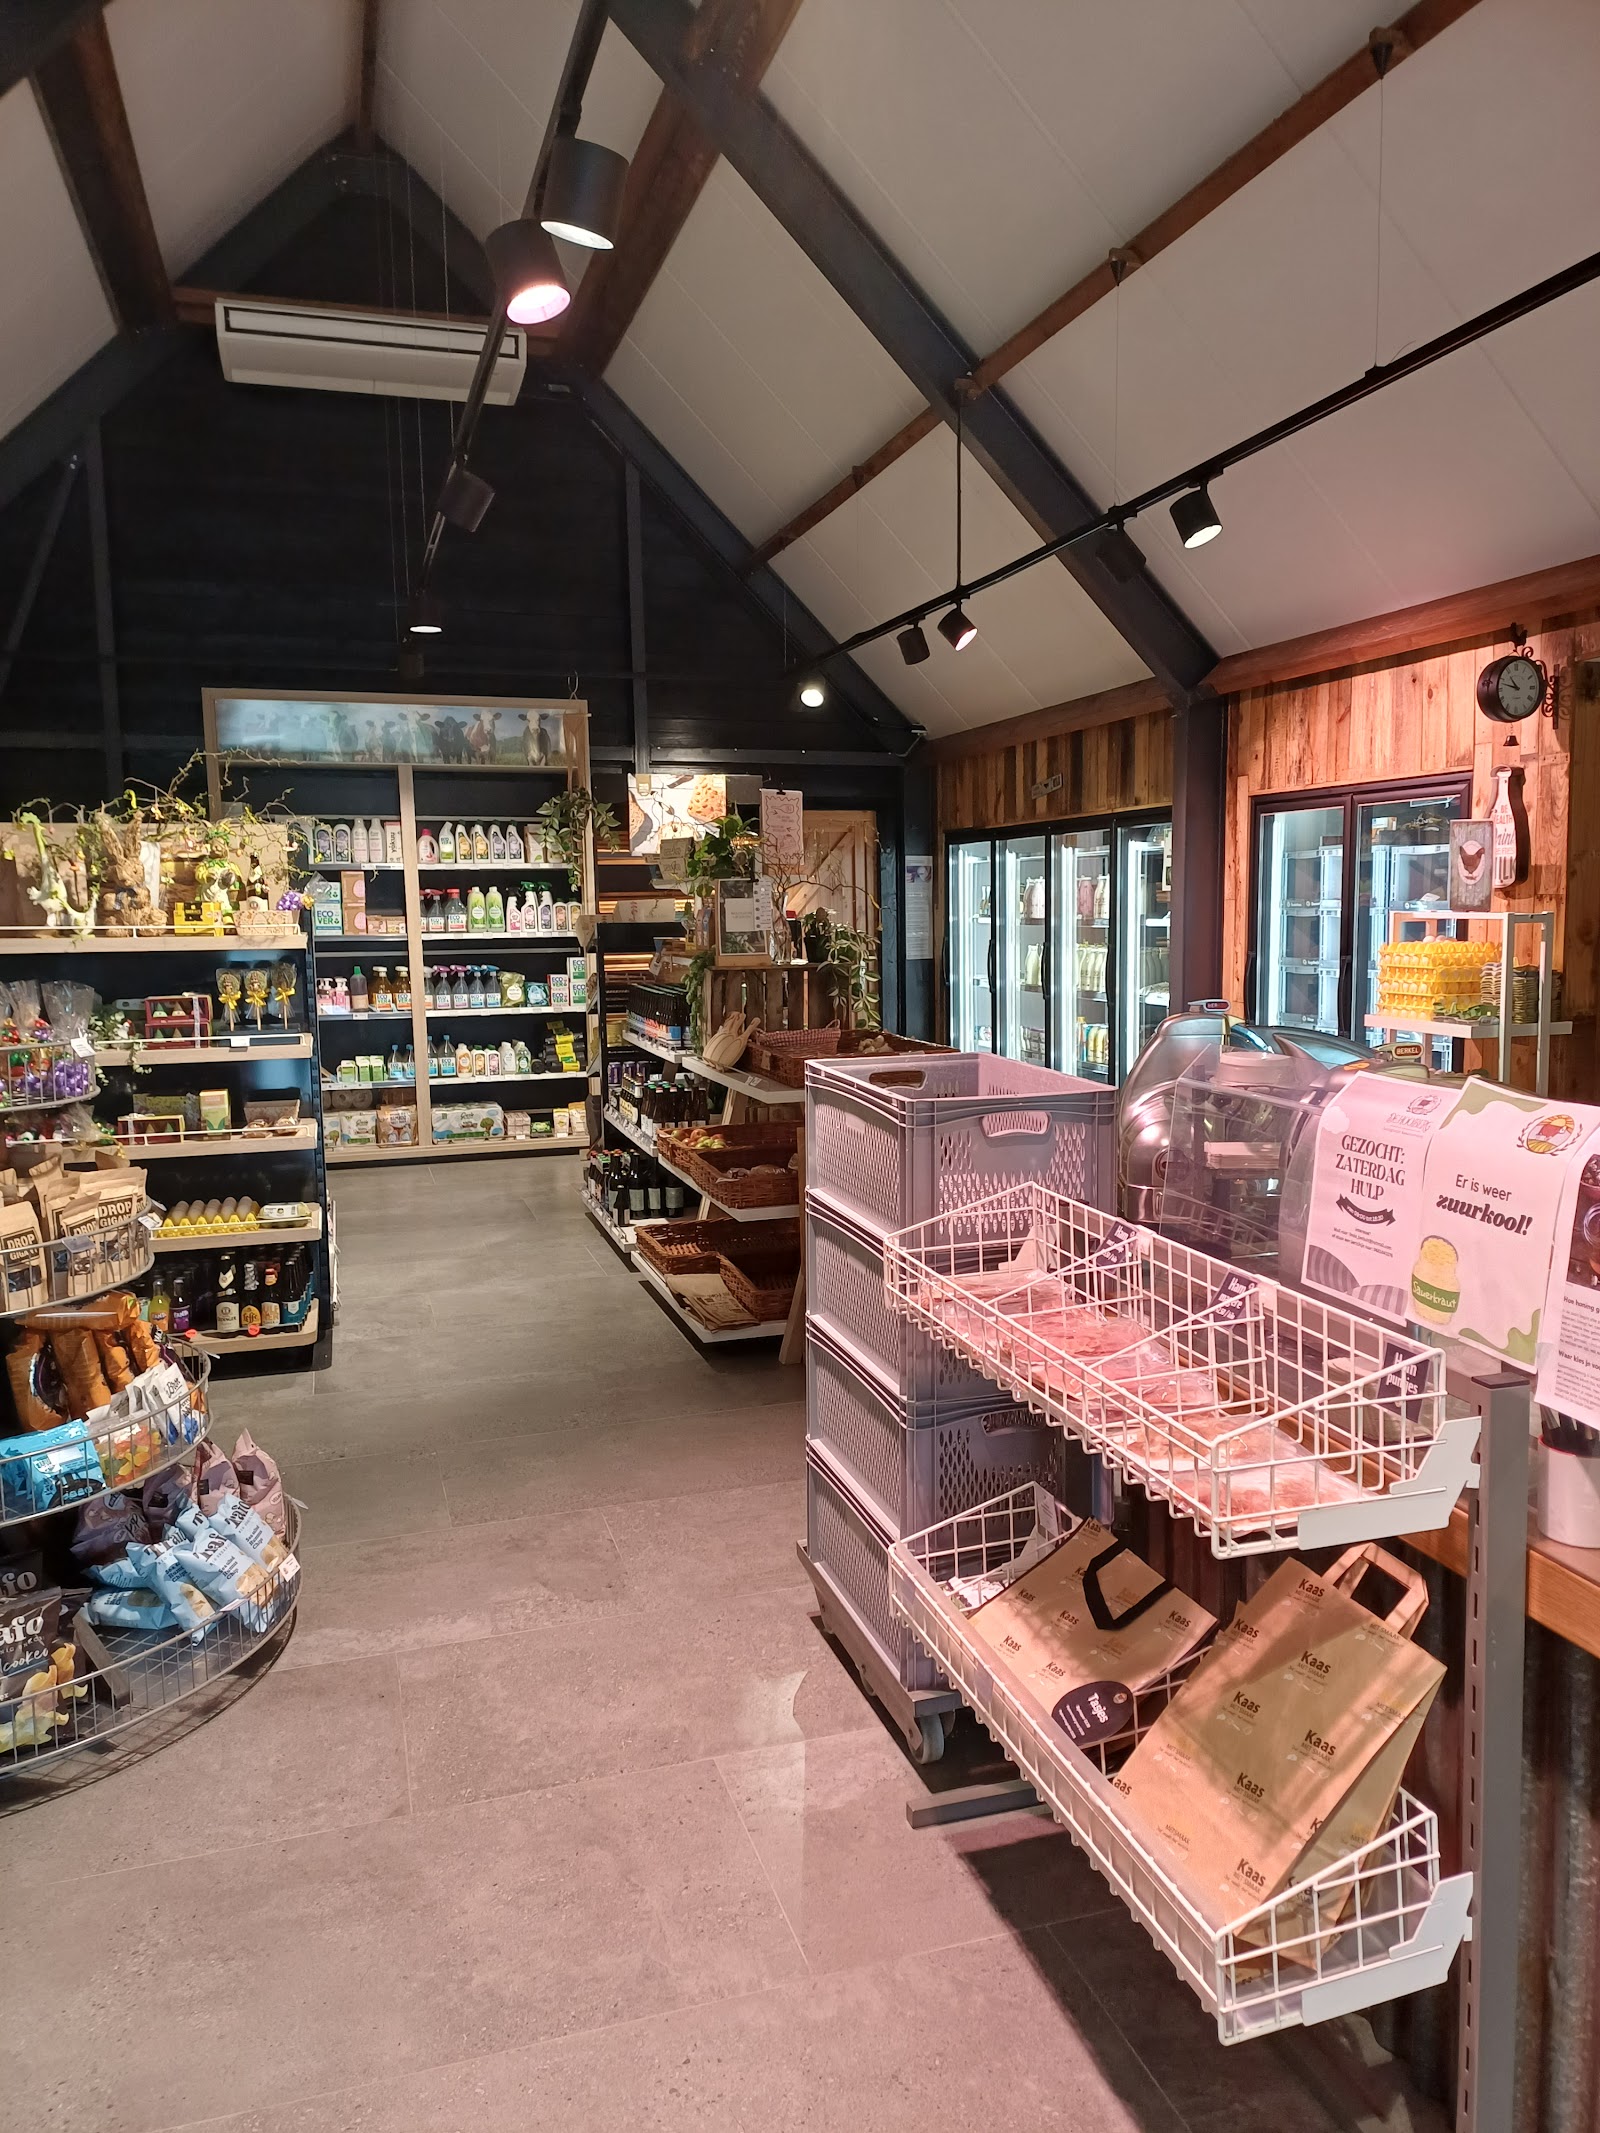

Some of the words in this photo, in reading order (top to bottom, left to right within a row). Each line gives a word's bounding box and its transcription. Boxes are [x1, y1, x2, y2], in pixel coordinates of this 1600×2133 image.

[1396, 1047, 1419, 1055] BERKEL
[1341, 1135, 1405, 1164] GEZOCHT:
[1335, 1153, 1405, 1186] ZATERDAG
[1350, 1178, 1384, 1200] HULP
[1456, 1174, 1469, 1188] Er
[1470, 1178, 1480, 1192] is
[1483, 1184, 1512, 1202] weer
[99, 1201, 132, 1218] DROP
[1436, 1194, 1533, 1236] zuurkool!
[7, 1234, 35, 1249] DROP
[1228, 1277, 1247, 1294] Ham
[1412, 1280, 1457, 1309] Sauerkraut
[1018, 1588, 1036, 1602] Kaas
[1299, 1579, 1325, 1597] Kaas
[1060, 1610, 1079, 1625] Kaas
[1168, 1611, 1192, 1628] Kaas
[1233, 1619, 1260, 1638] Kaas
[1003, 1635, 1022, 1652] Kaas
[1046, 1661, 1066, 1677] Kaas
[1300, 1651, 1331, 1674] Kaas
[1087, 1692, 1109, 1723] Tasjes
[1233, 1691, 1261, 1714] Kaas
[1304, 1730, 1336, 1756] Kaas
[1237, 1772, 1265, 1798] Kaas
[1237, 1858, 1266, 1887] Kaas
